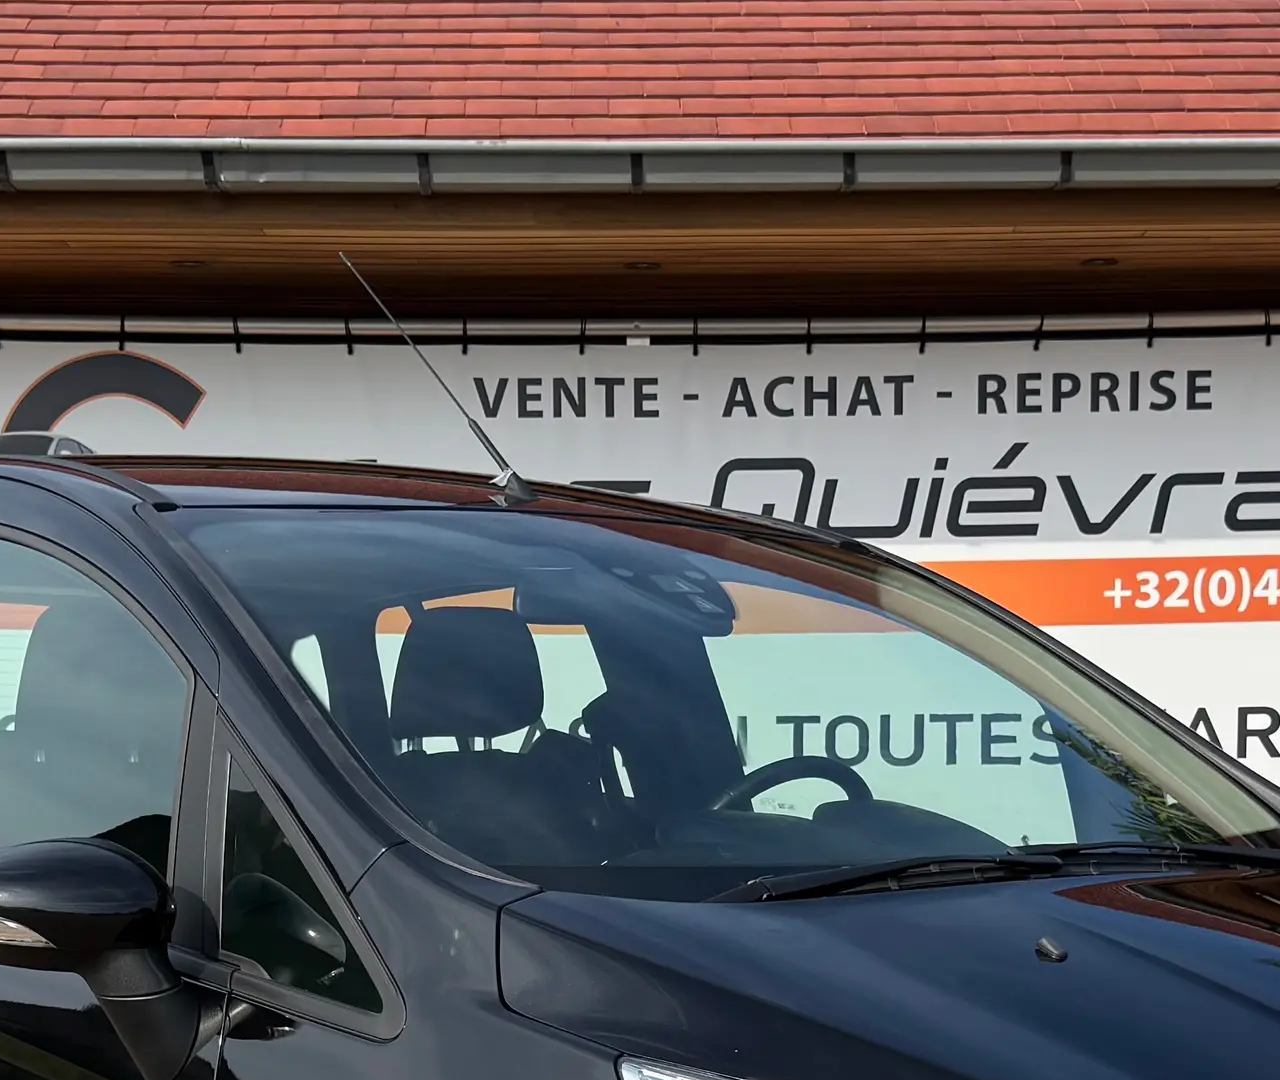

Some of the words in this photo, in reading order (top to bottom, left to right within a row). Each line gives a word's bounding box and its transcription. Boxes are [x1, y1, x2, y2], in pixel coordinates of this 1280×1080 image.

[472, 376, 661, 418] VENTE
[721, 374, 915, 418] ACHAT
[976, 370, 1214, 415] REPRISE
[775, 712, 1062, 767] TOUTES
